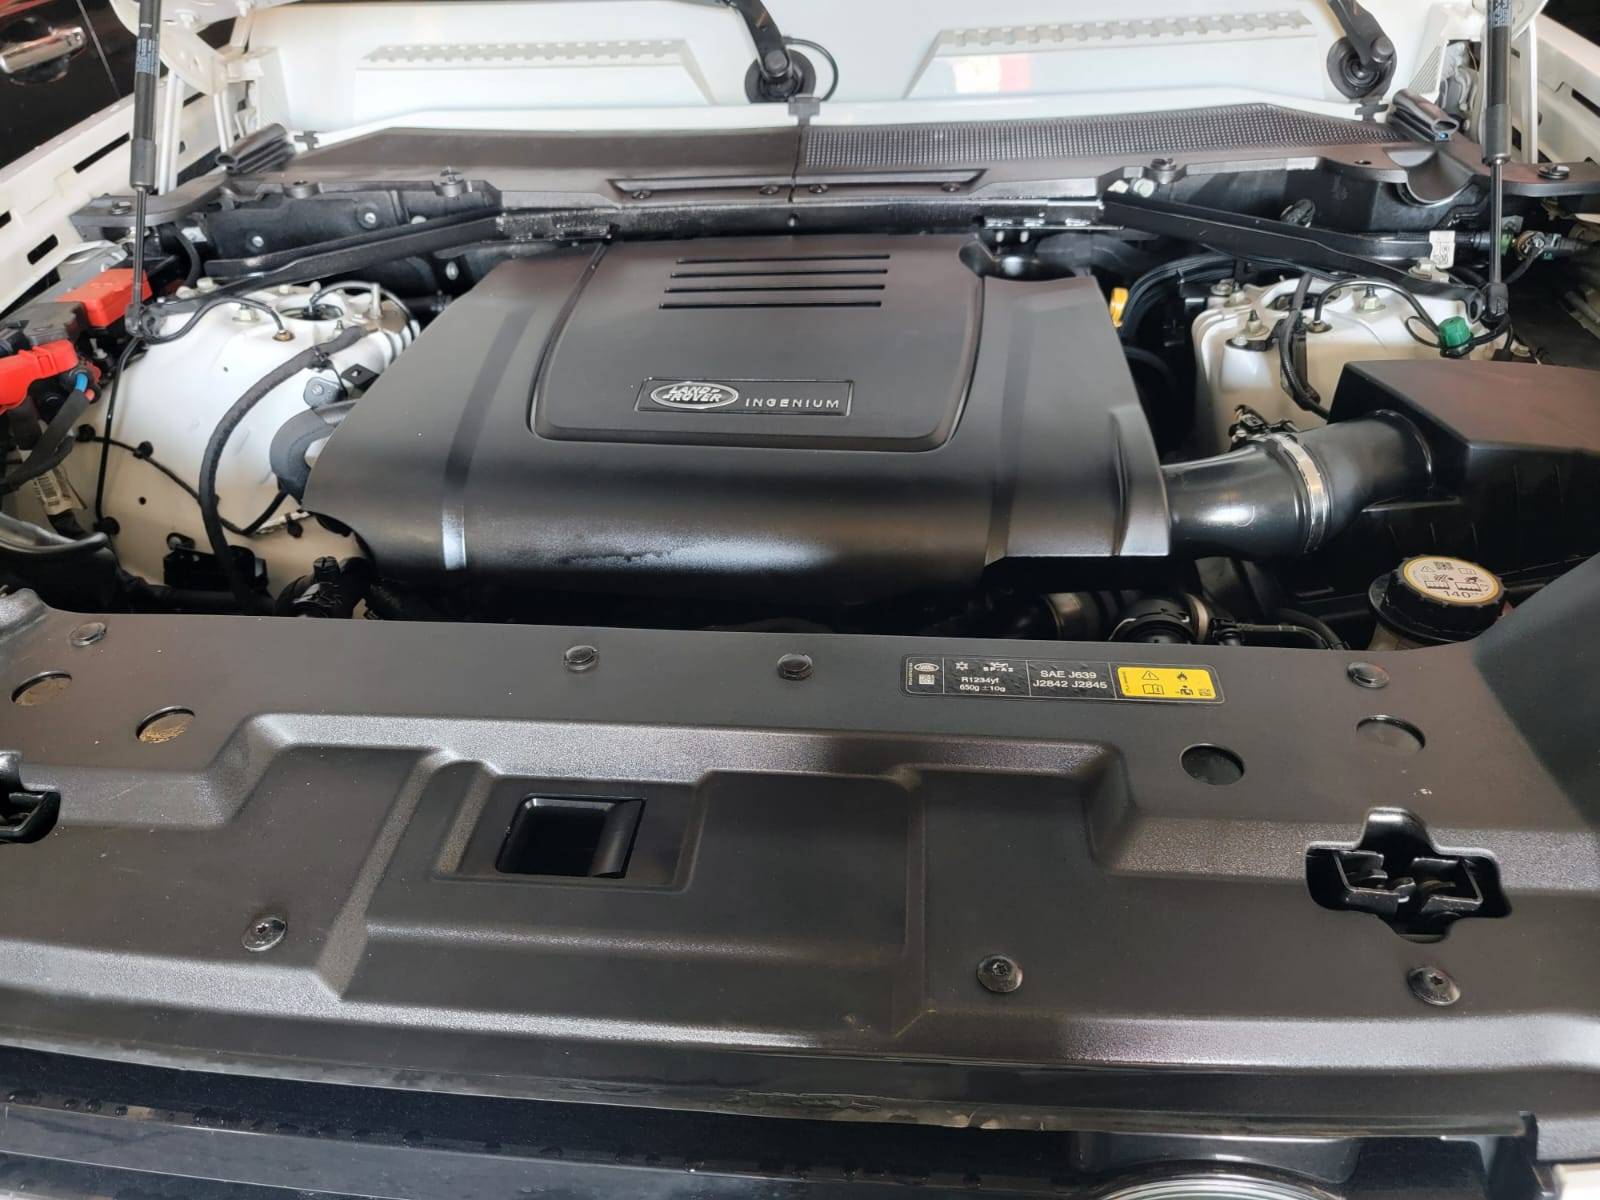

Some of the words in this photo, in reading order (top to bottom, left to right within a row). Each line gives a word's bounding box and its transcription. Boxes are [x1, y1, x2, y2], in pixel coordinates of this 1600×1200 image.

[669, 386, 711, 394] LAND
[670, 393, 722, 402] ROVER
[745, 398, 840, 408] INGENIUM
[1040, 670, 1066, 678] SAE
[1068, 671, 1097, 679] J639
[961, 676, 1000, 685] R1234yf
[1032, 680, 1068, 688] J2842
[1071, 681, 1108, 689] J2845
[959, 684, 980, 692] 650g
